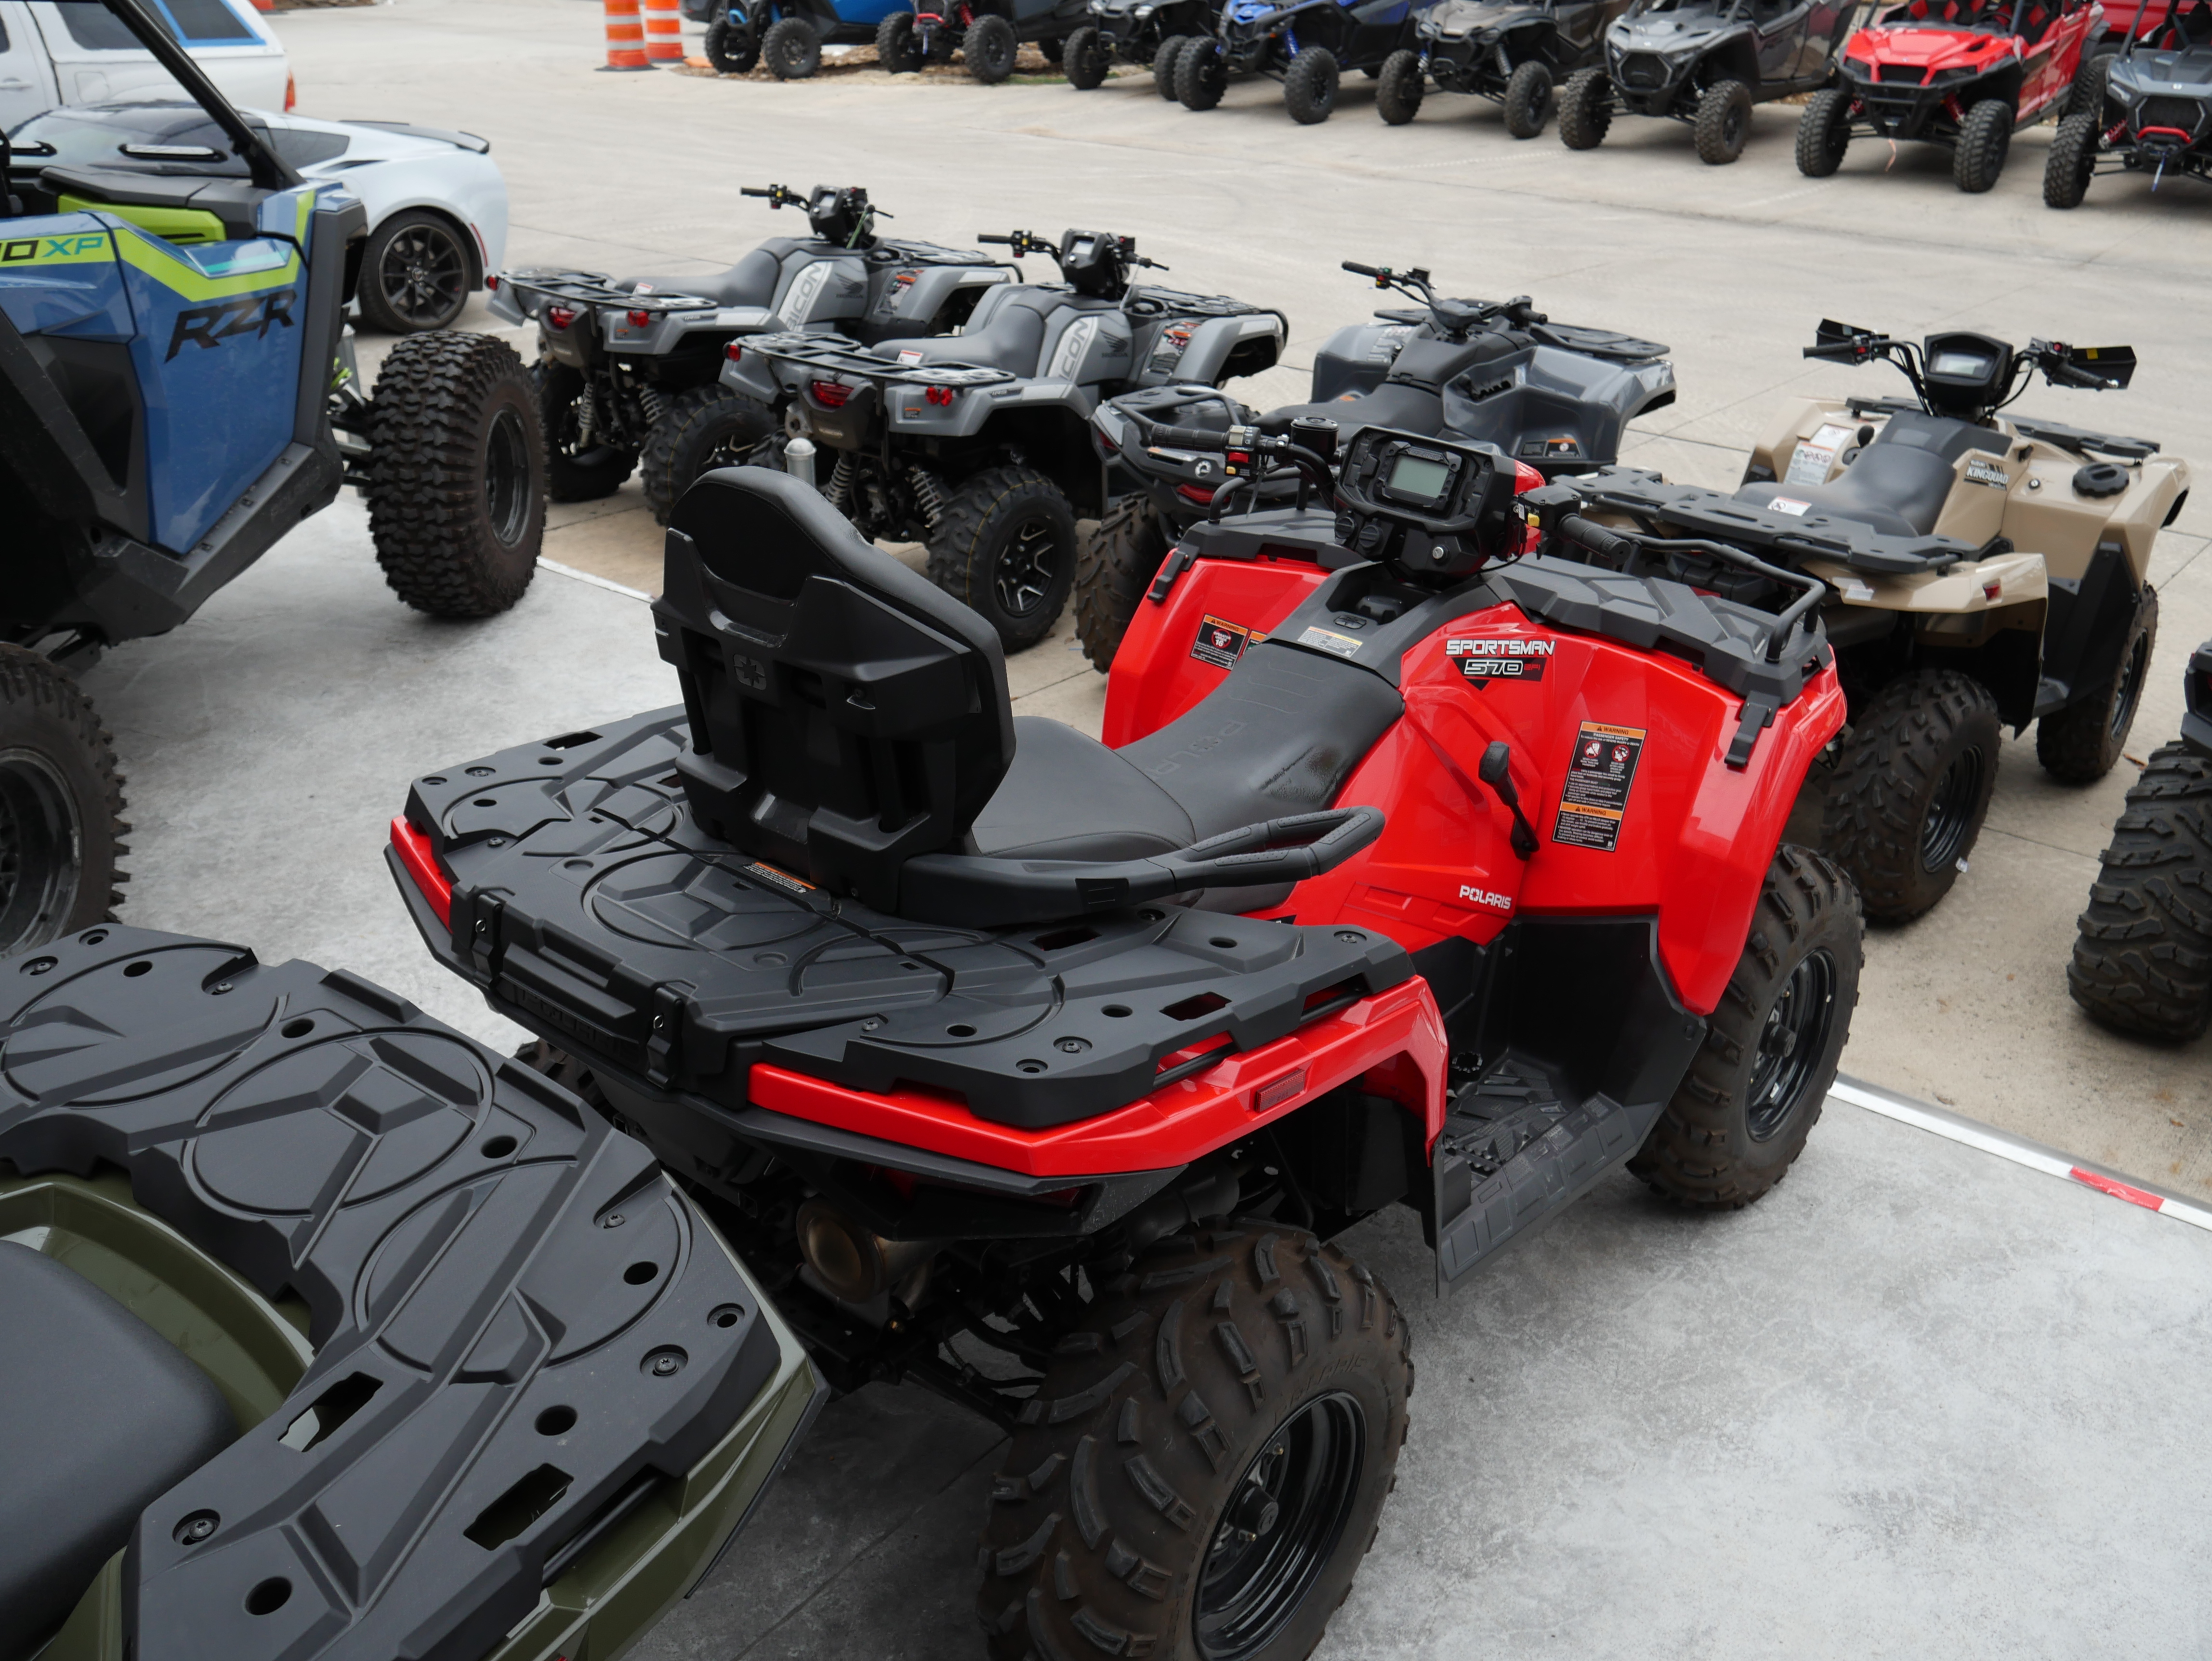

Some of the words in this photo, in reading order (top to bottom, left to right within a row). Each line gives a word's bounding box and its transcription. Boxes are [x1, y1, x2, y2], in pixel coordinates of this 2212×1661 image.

[0, 240, 39, 262] 0
[42, 237, 104, 257] XP
[786, 264, 821, 331] BICON
[164, 289, 297, 364] RZR
[1966, 466, 2009, 485] KINGQUAD
[1216, 621, 1239, 632] WARNING
[1446, 640, 1555, 655] SPORTSMAN
[1464, 659, 1523, 675] 570
[1604, 726, 1629, 735] WARNING
[1581, 807, 1606, 816] WARNING
[1459, 885, 1512, 910] POLARIS
